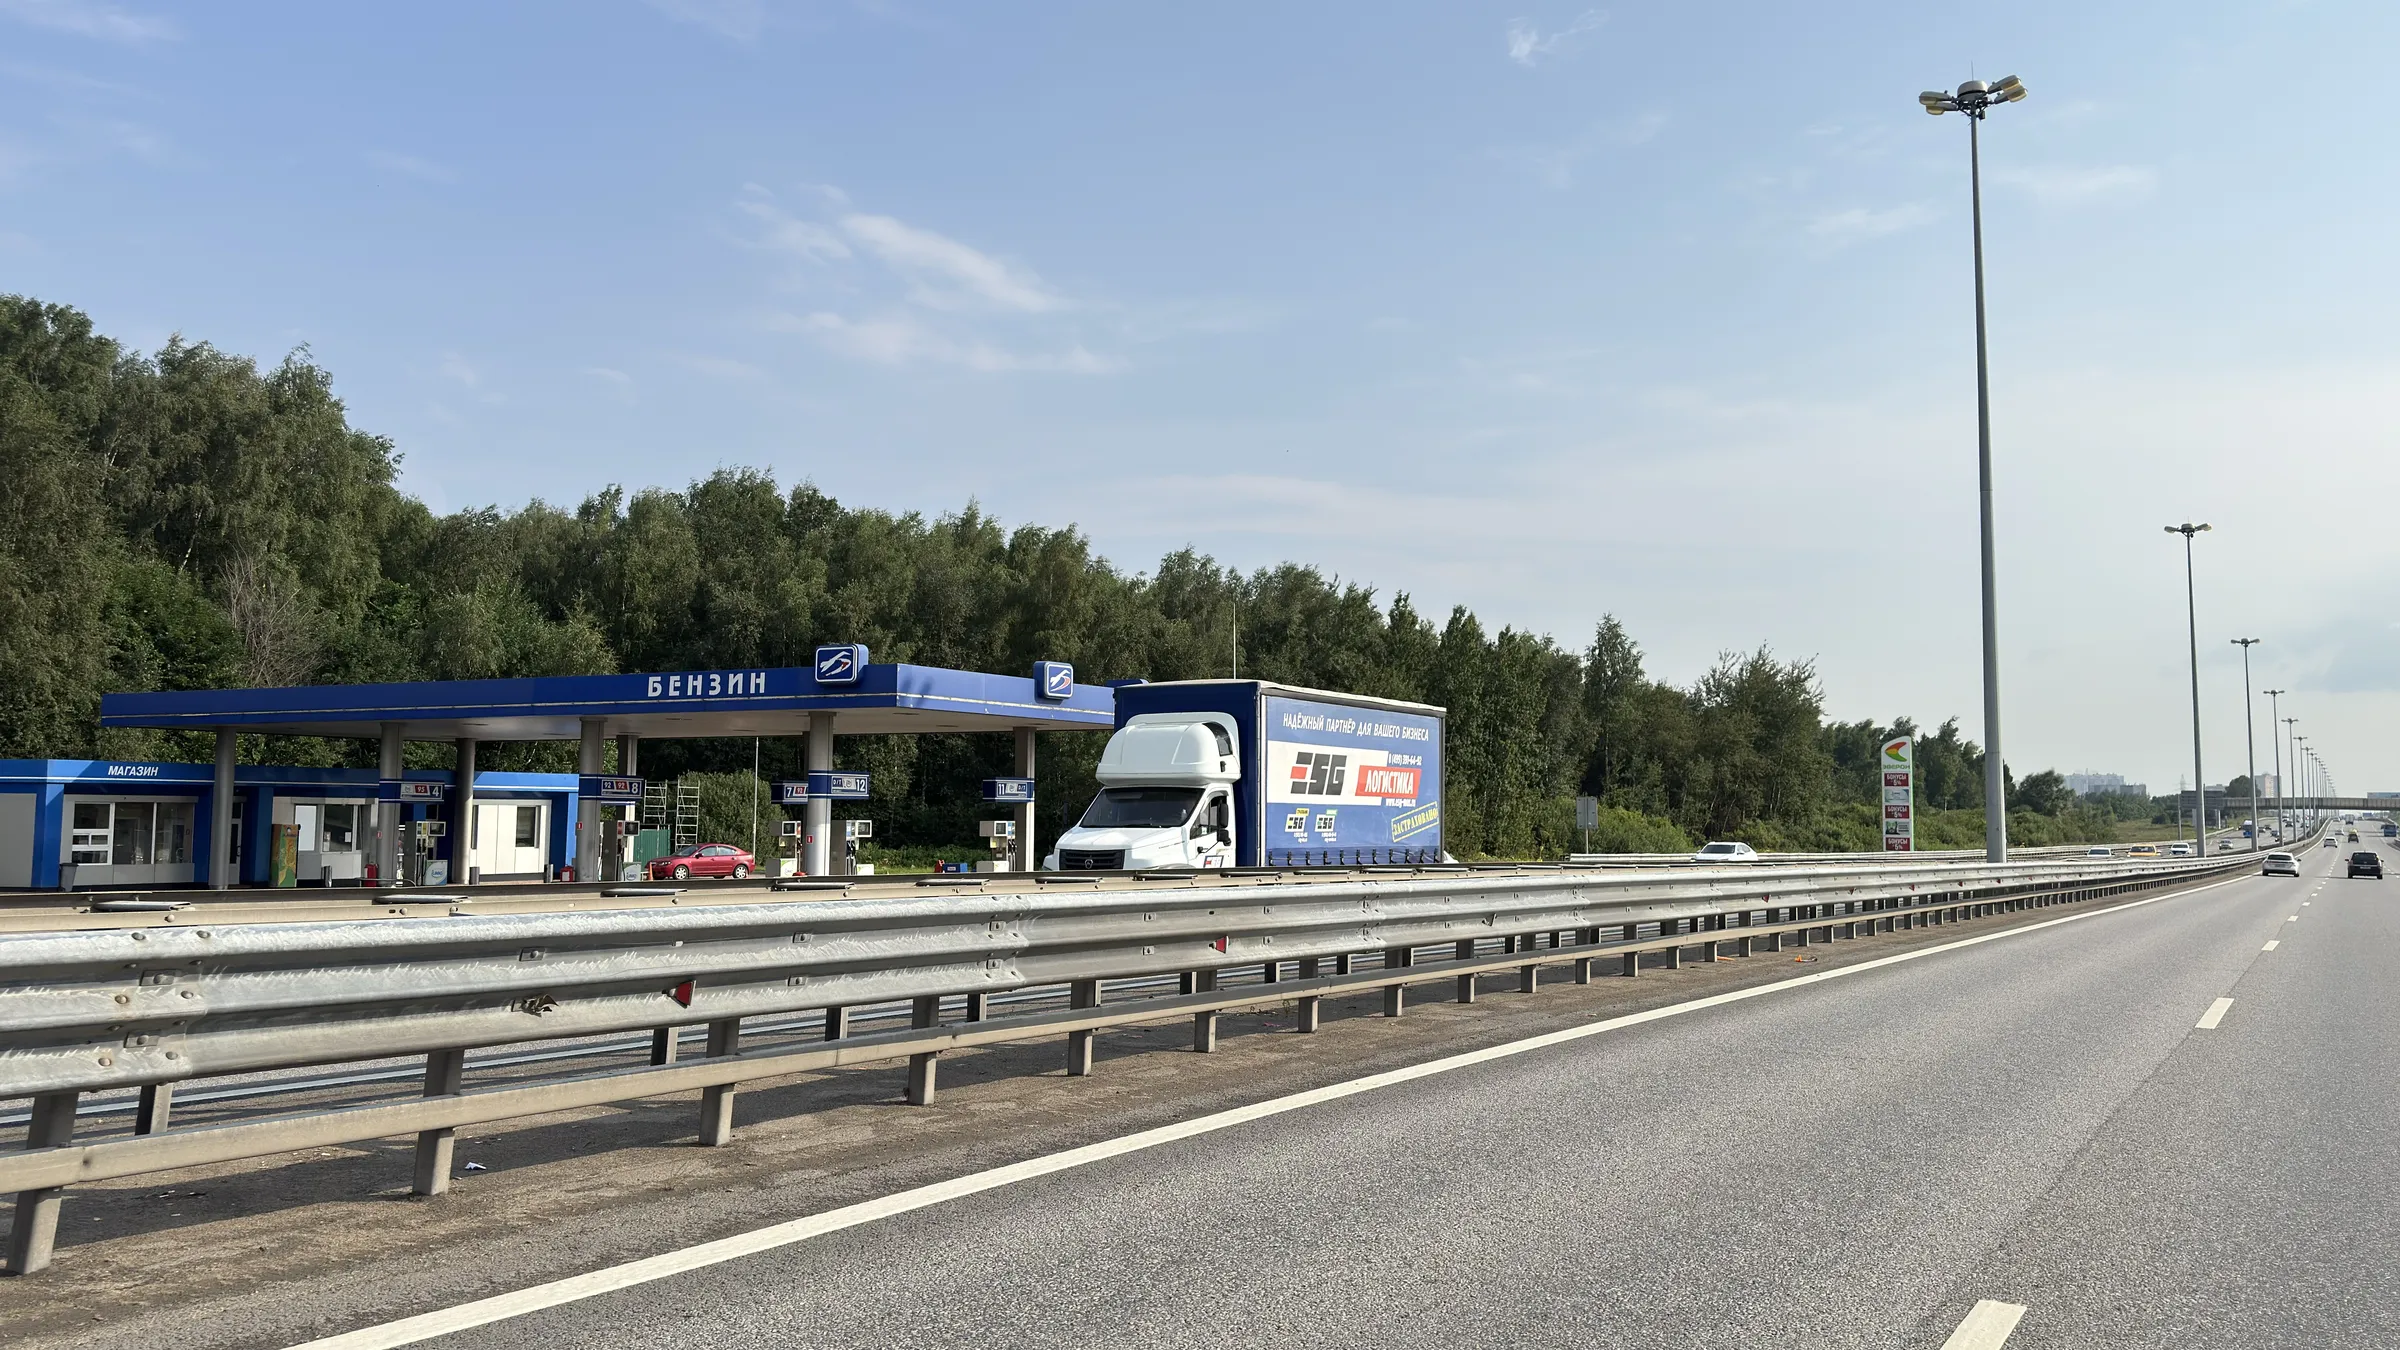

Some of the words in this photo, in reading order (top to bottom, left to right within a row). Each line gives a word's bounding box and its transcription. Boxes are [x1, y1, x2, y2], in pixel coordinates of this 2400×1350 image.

[648, 672, 766, 697] БЕНЗИН
[1283, 712, 1324, 731] НАДЁЖНЫЙ
[1326, 717, 1356, 735] ПАРТНЁР
[1357, 722, 1372, 737] ДЛЯ
[1373, 723, 1400, 739] ВАШЕГО
[1401, 726, 1429, 742] БИЗНЕСА
[108, 765, 159, 777] МАГАЗИН
[1290, 751, 1348, 796] ESG
[604, 781, 612, 789] 92
[631, 782, 639, 794] 8
[856, 779, 866, 792] 12
[1364, 769, 1414, 795] ЛОГИСТИКА
[432, 786, 440, 797] 4
[786, 787, 792, 797] 7
[998, 783, 1005, 795] 11
[1393, 808, 1438, 836] ЗАСТРАХОВАНО
